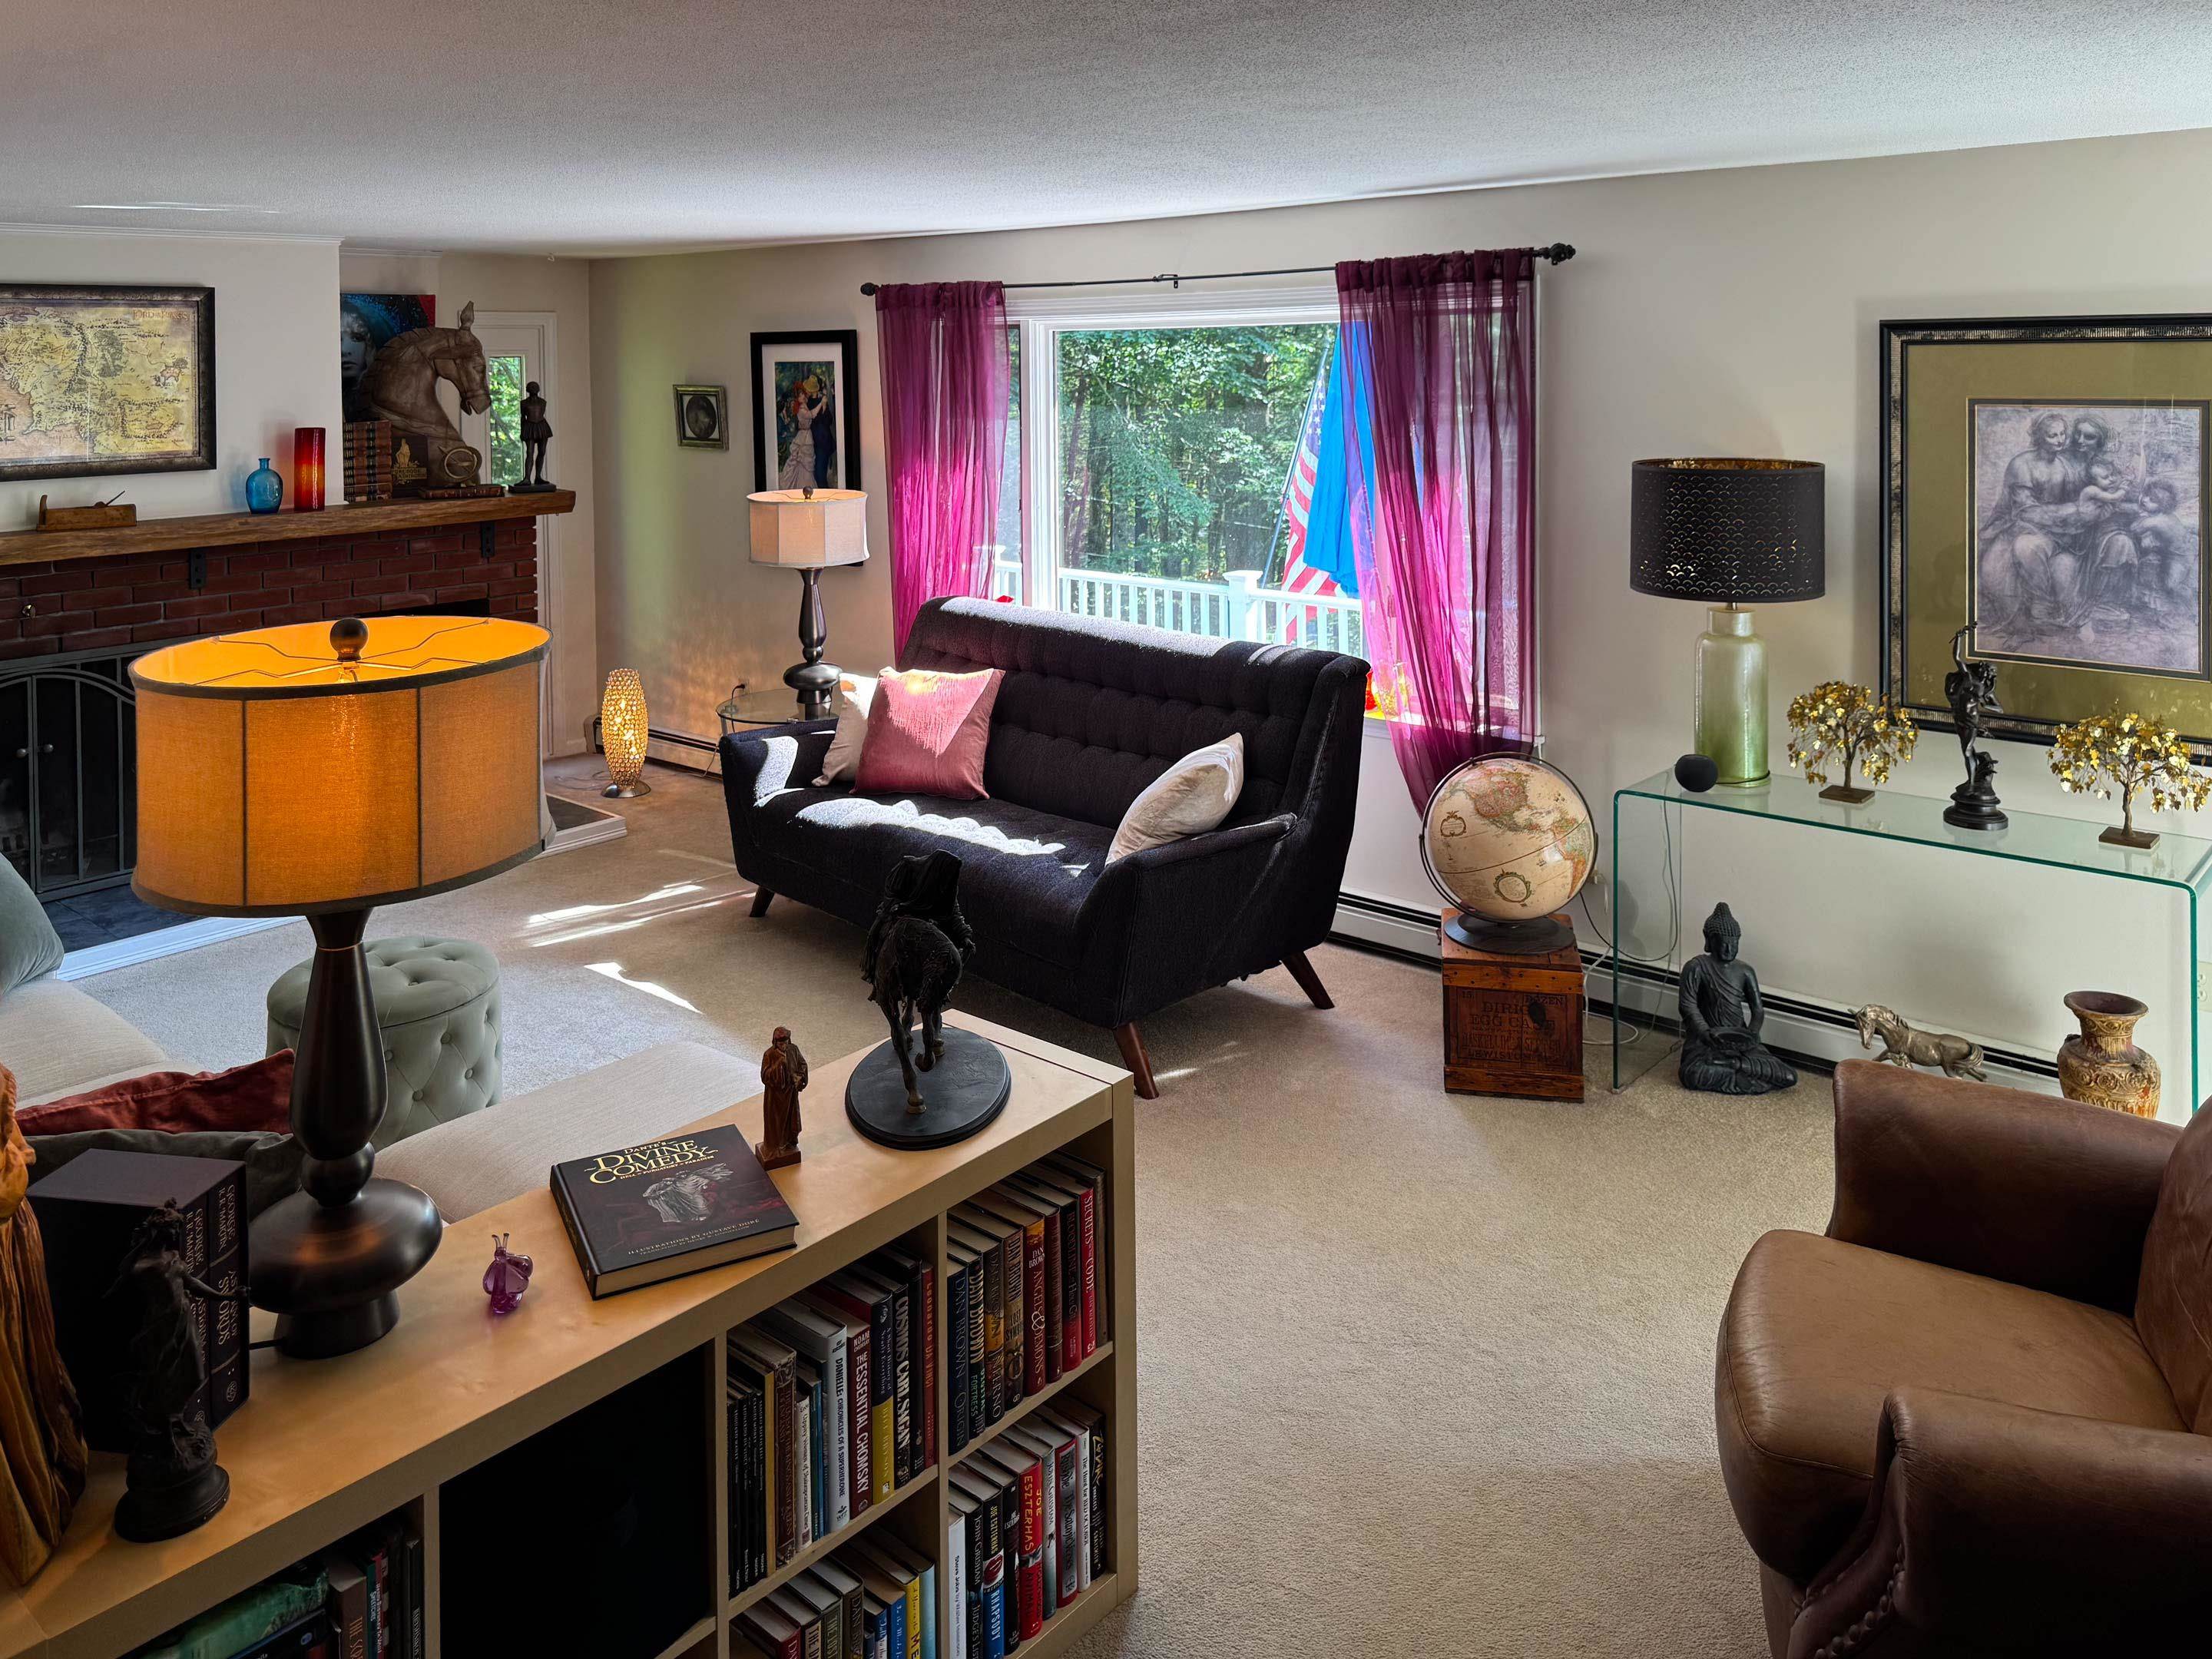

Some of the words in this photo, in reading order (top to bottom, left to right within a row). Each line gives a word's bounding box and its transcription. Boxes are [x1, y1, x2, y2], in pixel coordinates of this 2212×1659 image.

[590, 1147, 711, 1184] COMEDY
[593, 1141, 697, 1171] DIVINE
[624, 1141, 667, 1155] DANTE'S
[643, 1164, 678, 1175] PURGATORY
[227, 1184, 237, 1241] GEORGE
[1084, 1196, 1094, 1244] SECRETS
[194, 1208, 204, 1266] GEORGE
[1008, 1237, 1021, 1262] DAN
[955, 1277, 965, 1314] DAN
[969, 1269, 983, 1305] DAN
[1008, 1261, 1021, 1303] BROWN
[1034, 1270, 1043, 1313] ANGELS
[1085, 1257, 1095, 1294] CODE
[854, 1330, 869, 1347] NOAM
[896, 1296, 909, 1362] COSMOS
[969, 1303, 984, 1364] BROWN
[1031, 1311, 1045, 1331] &
[856, 1352, 868, 1366] THE
[955, 1317, 965, 1379] BROWN
[1035, 1329, 1044, 1373] DEMONS
[836, 1357, 844, 1397] DANIELLE:
[856, 1360, 868, 1433] ESSENTIAL
[896, 1360, 909, 1399] CARL
[970, 1375, 979, 1418] FORTRESS
[988, 1347, 1004, 1418] INFERNO
[838, 1436, 844, 1445] OF
[896, 1398, 910, 1449] SAGAN
[955, 1392, 967, 1449] ORIGIN
[856, 1432, 869, 1494] CHOMSKY
[990, 1505, 999, 1518] JOE
[1024, 1475, 1035, 1551] ESZTERHAS
[1047, 1484, 1055, 1525] GRISHAM
[973, 1514, 983, 1541] JOHN
[990, 1518, 999, 1555] ESZTERHAS
[1062, 1510, 1077, 1542] Satanic
[973, 1541, 983, 1585] GRISHAM
[991, 1589, 1001, 1641] RHAPSODY
[808, 1625, 820, 1648] THE
